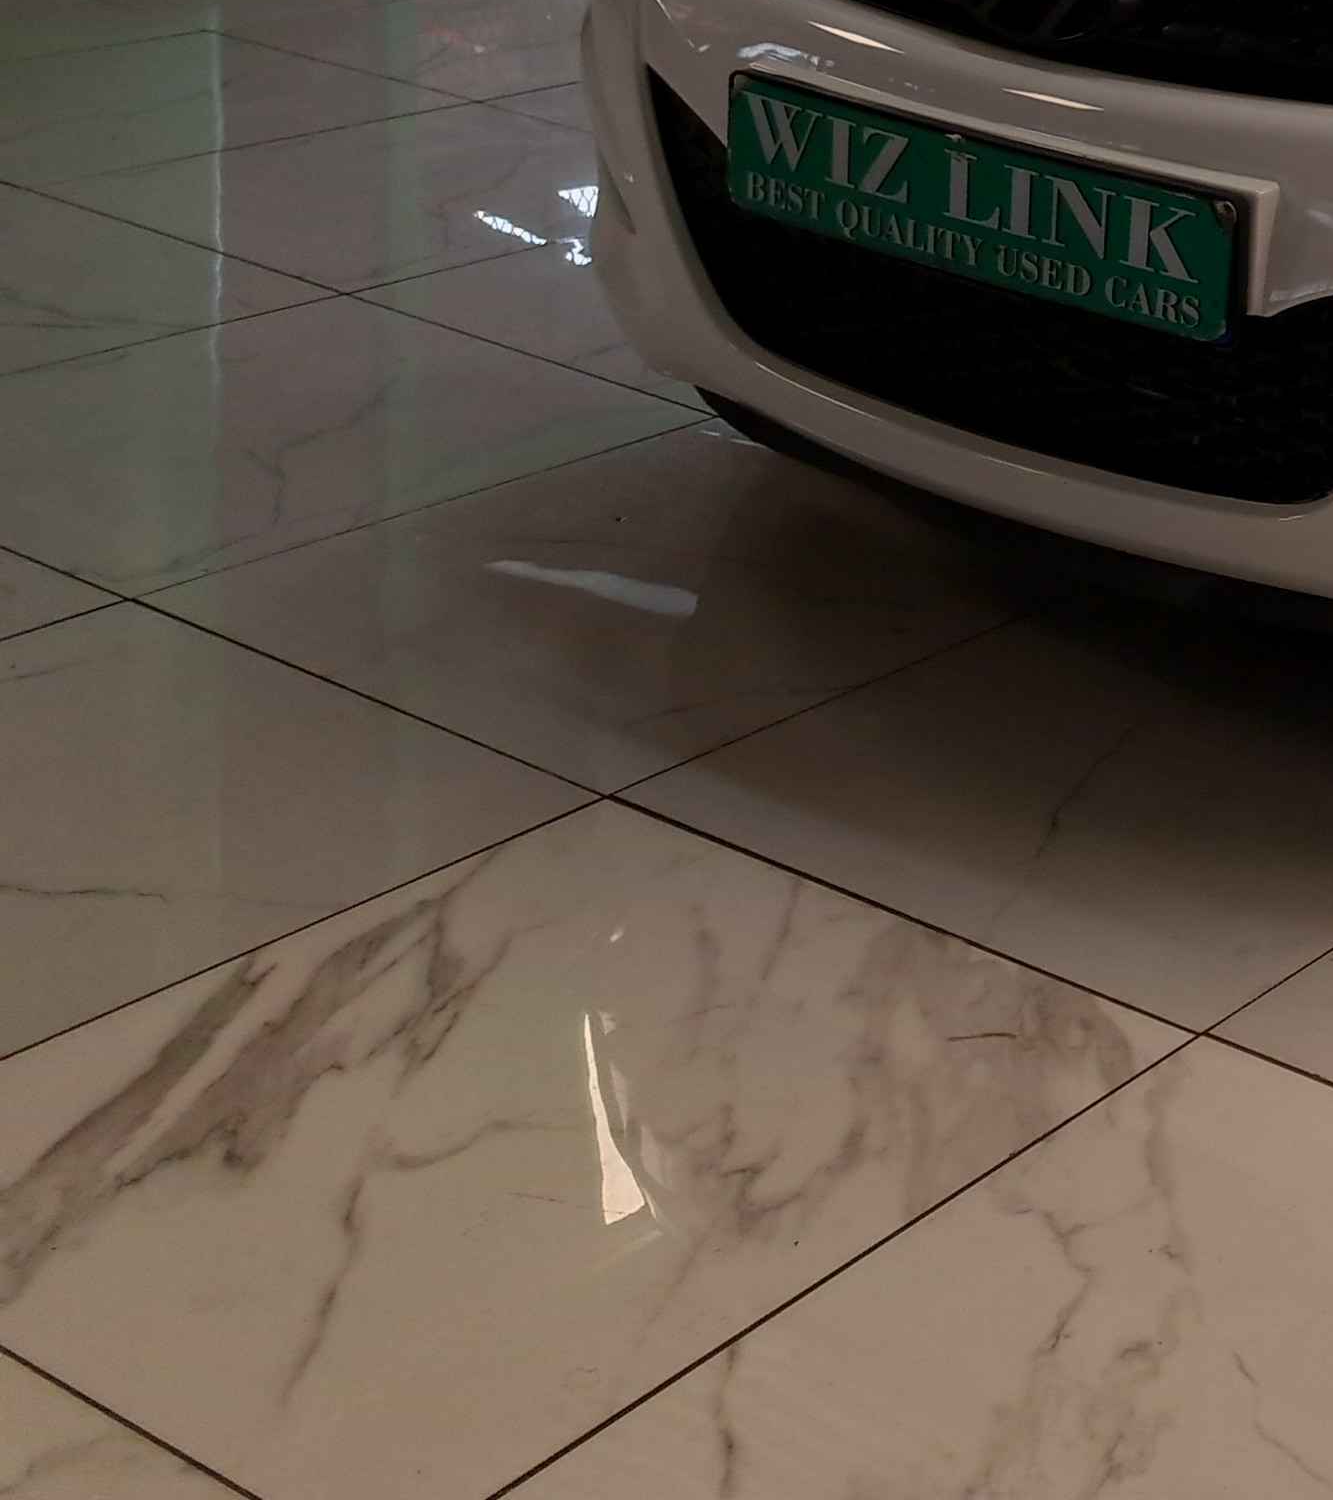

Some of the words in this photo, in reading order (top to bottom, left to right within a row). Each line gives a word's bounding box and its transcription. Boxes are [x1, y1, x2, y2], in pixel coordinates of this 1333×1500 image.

[741, 91, 911, 205] WIZ
[943, 147, 1199, 284] LINK
[745, 170, 827, 221] BEST
[834, 202, 985, 267] QUALITY
[995, 246, 1092, 298] USED
[1105, 275, 1201, 328] CARS
